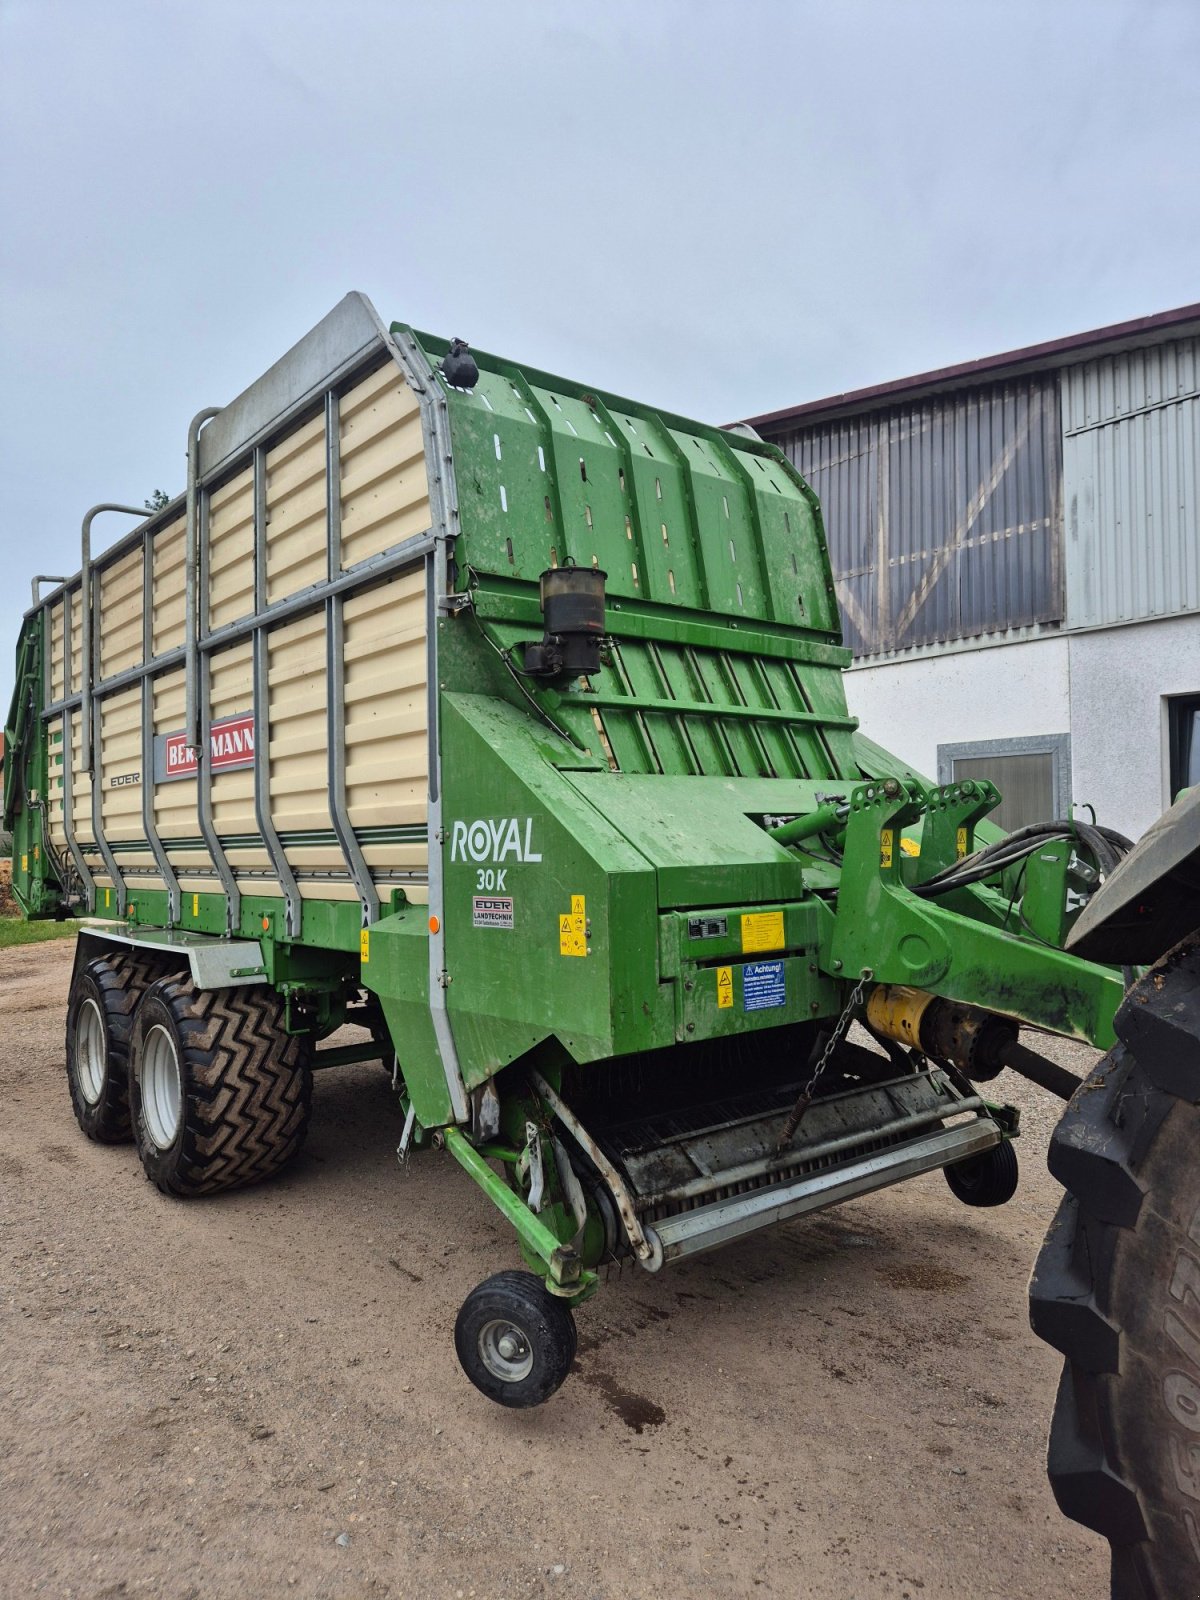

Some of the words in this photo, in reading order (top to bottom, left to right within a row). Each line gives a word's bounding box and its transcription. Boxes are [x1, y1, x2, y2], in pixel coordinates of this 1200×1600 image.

[169, 728, 255, 766] BERMANN
[111, 773, 140, 787] EDER
[451, 818, 542, 862] ROYAL
[476, 869, 495, 890] 30
[496, 869, 508, 891] K
[475, 900, 512, 910] EDER
[474, 912, 513, 921] LANDTECHNIK
[754, 962, 782, 974] Achtung!
